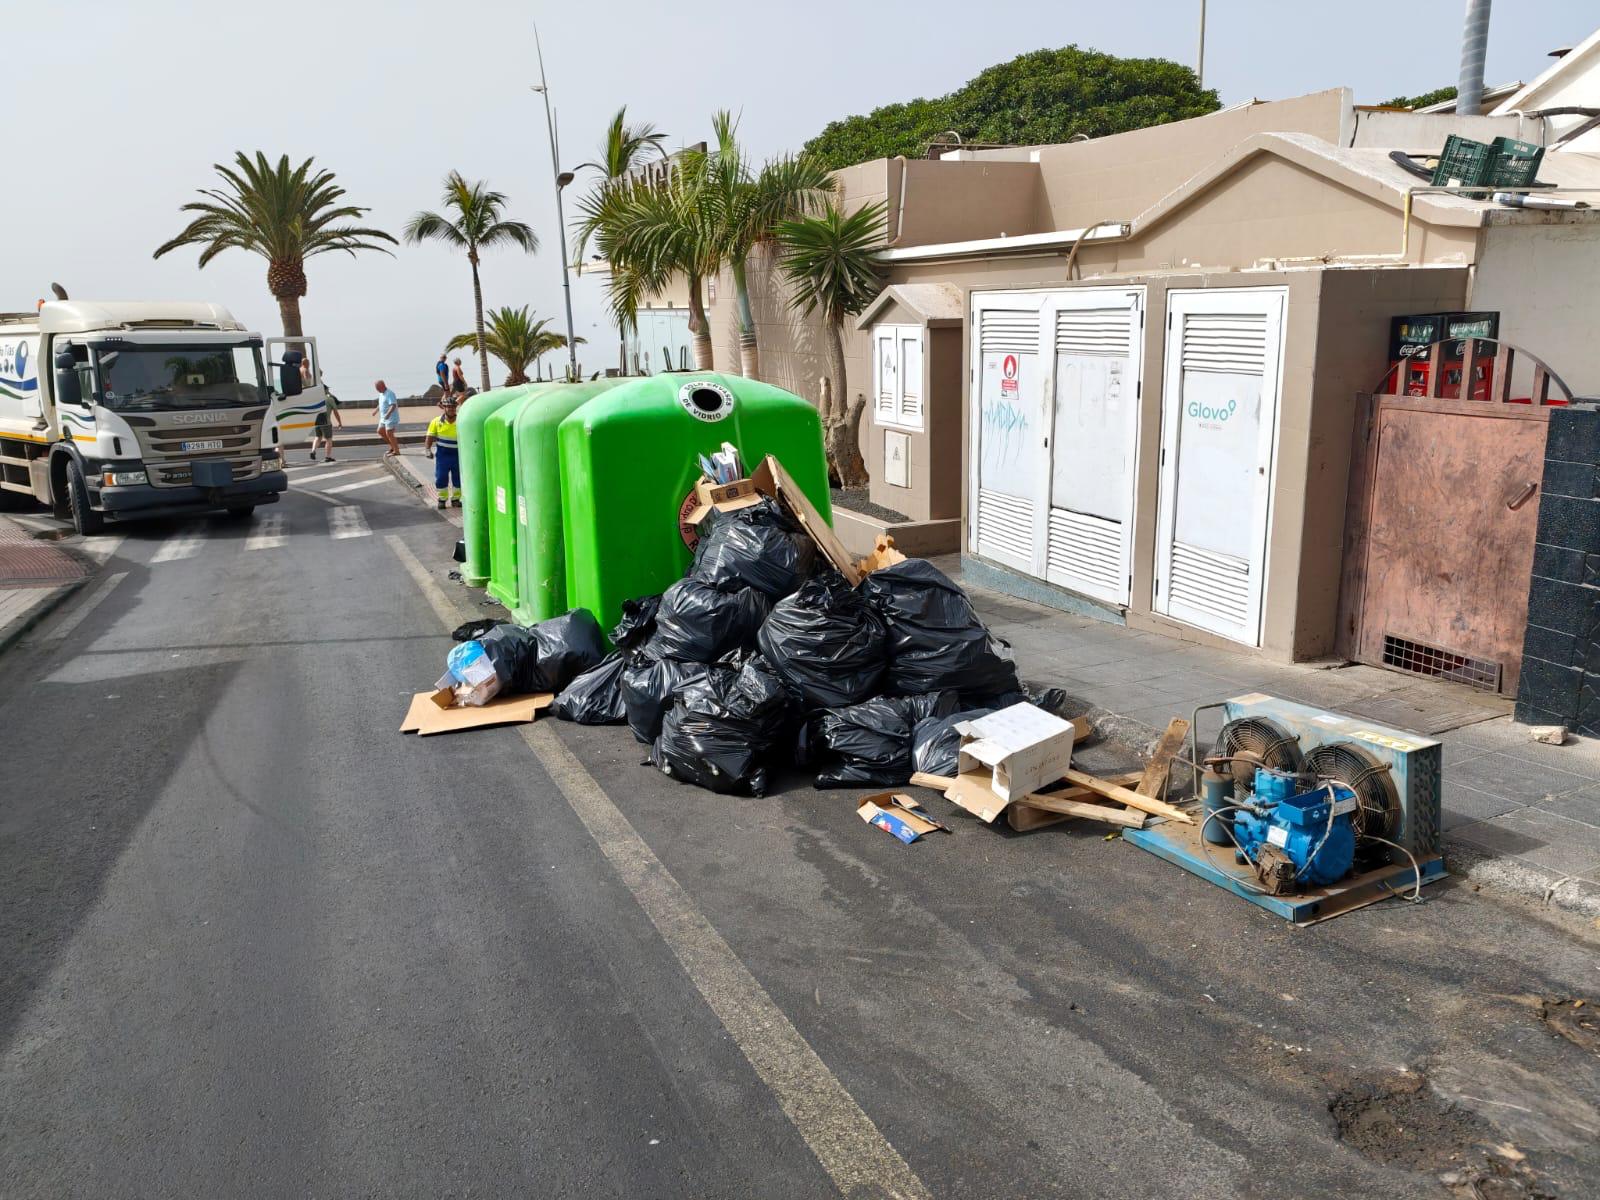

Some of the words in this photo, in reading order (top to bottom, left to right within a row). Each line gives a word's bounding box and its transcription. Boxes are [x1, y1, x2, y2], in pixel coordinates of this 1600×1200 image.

[172, 412, 228, 425] SCANIA
[683, 398, 692, 407] DE
[693, 408, 722, 421] VIDRIO
[1188, 401, 1229, 421] Glovo
